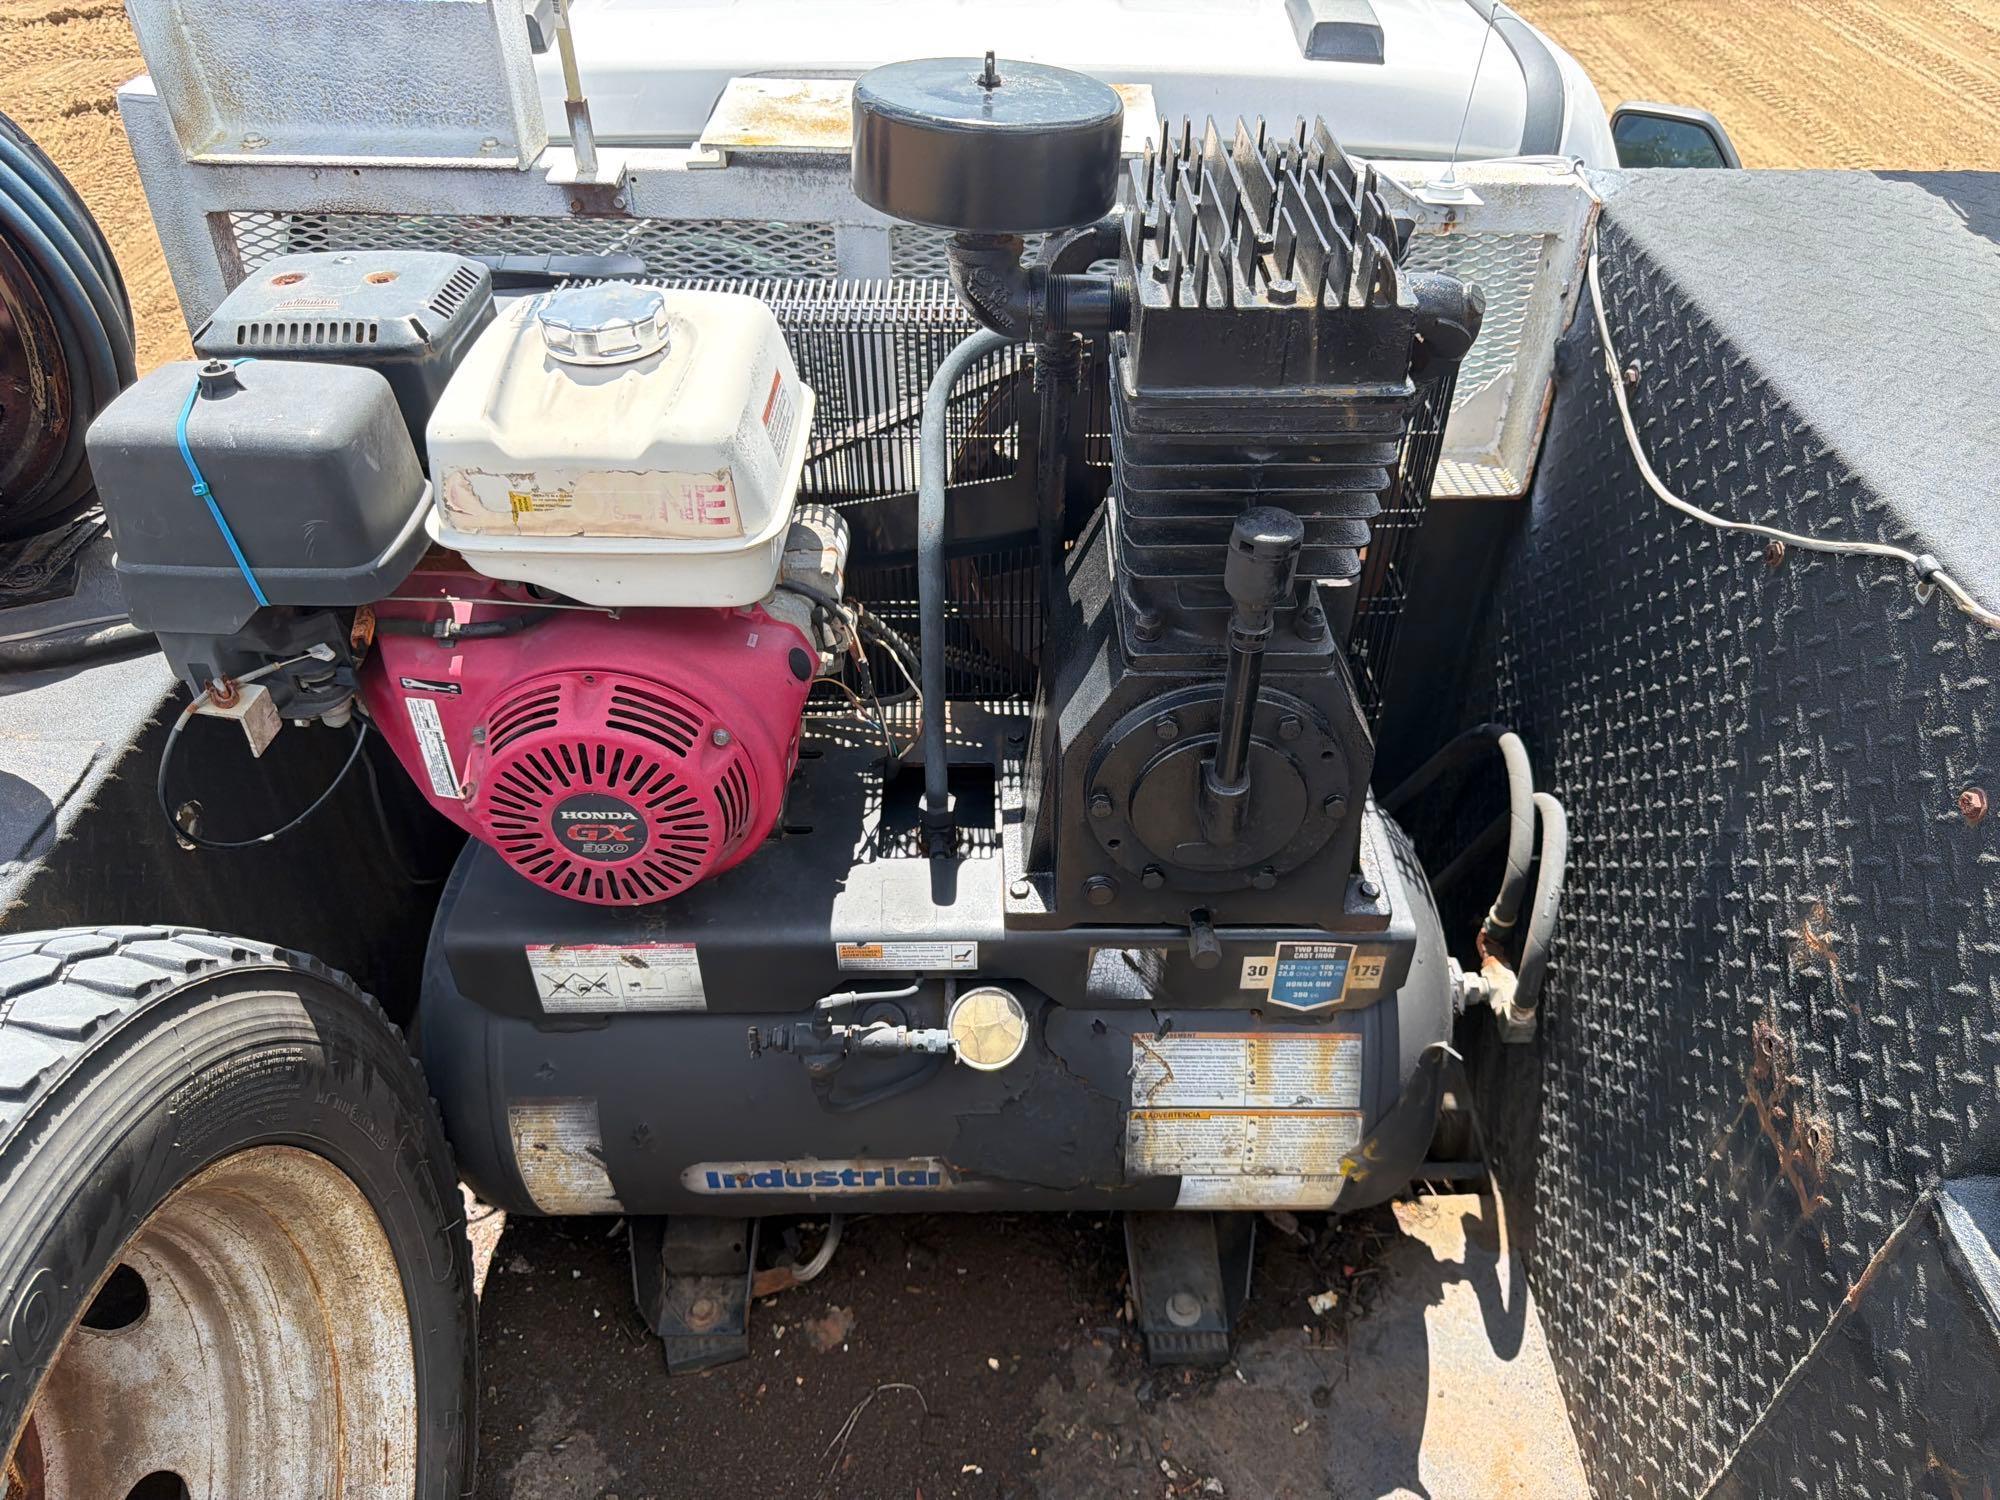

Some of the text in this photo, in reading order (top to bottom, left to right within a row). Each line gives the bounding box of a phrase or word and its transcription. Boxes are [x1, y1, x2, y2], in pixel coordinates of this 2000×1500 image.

[560, 811, 639, 820] HONDA
[566, 823, 636, 842] GX
[582, 843, 629, 854] 390
[1247, 965, 1269, 977] 30
[1352, 965, 1381, 977] 175
[705, 1168, 940, 1189] Industrial
